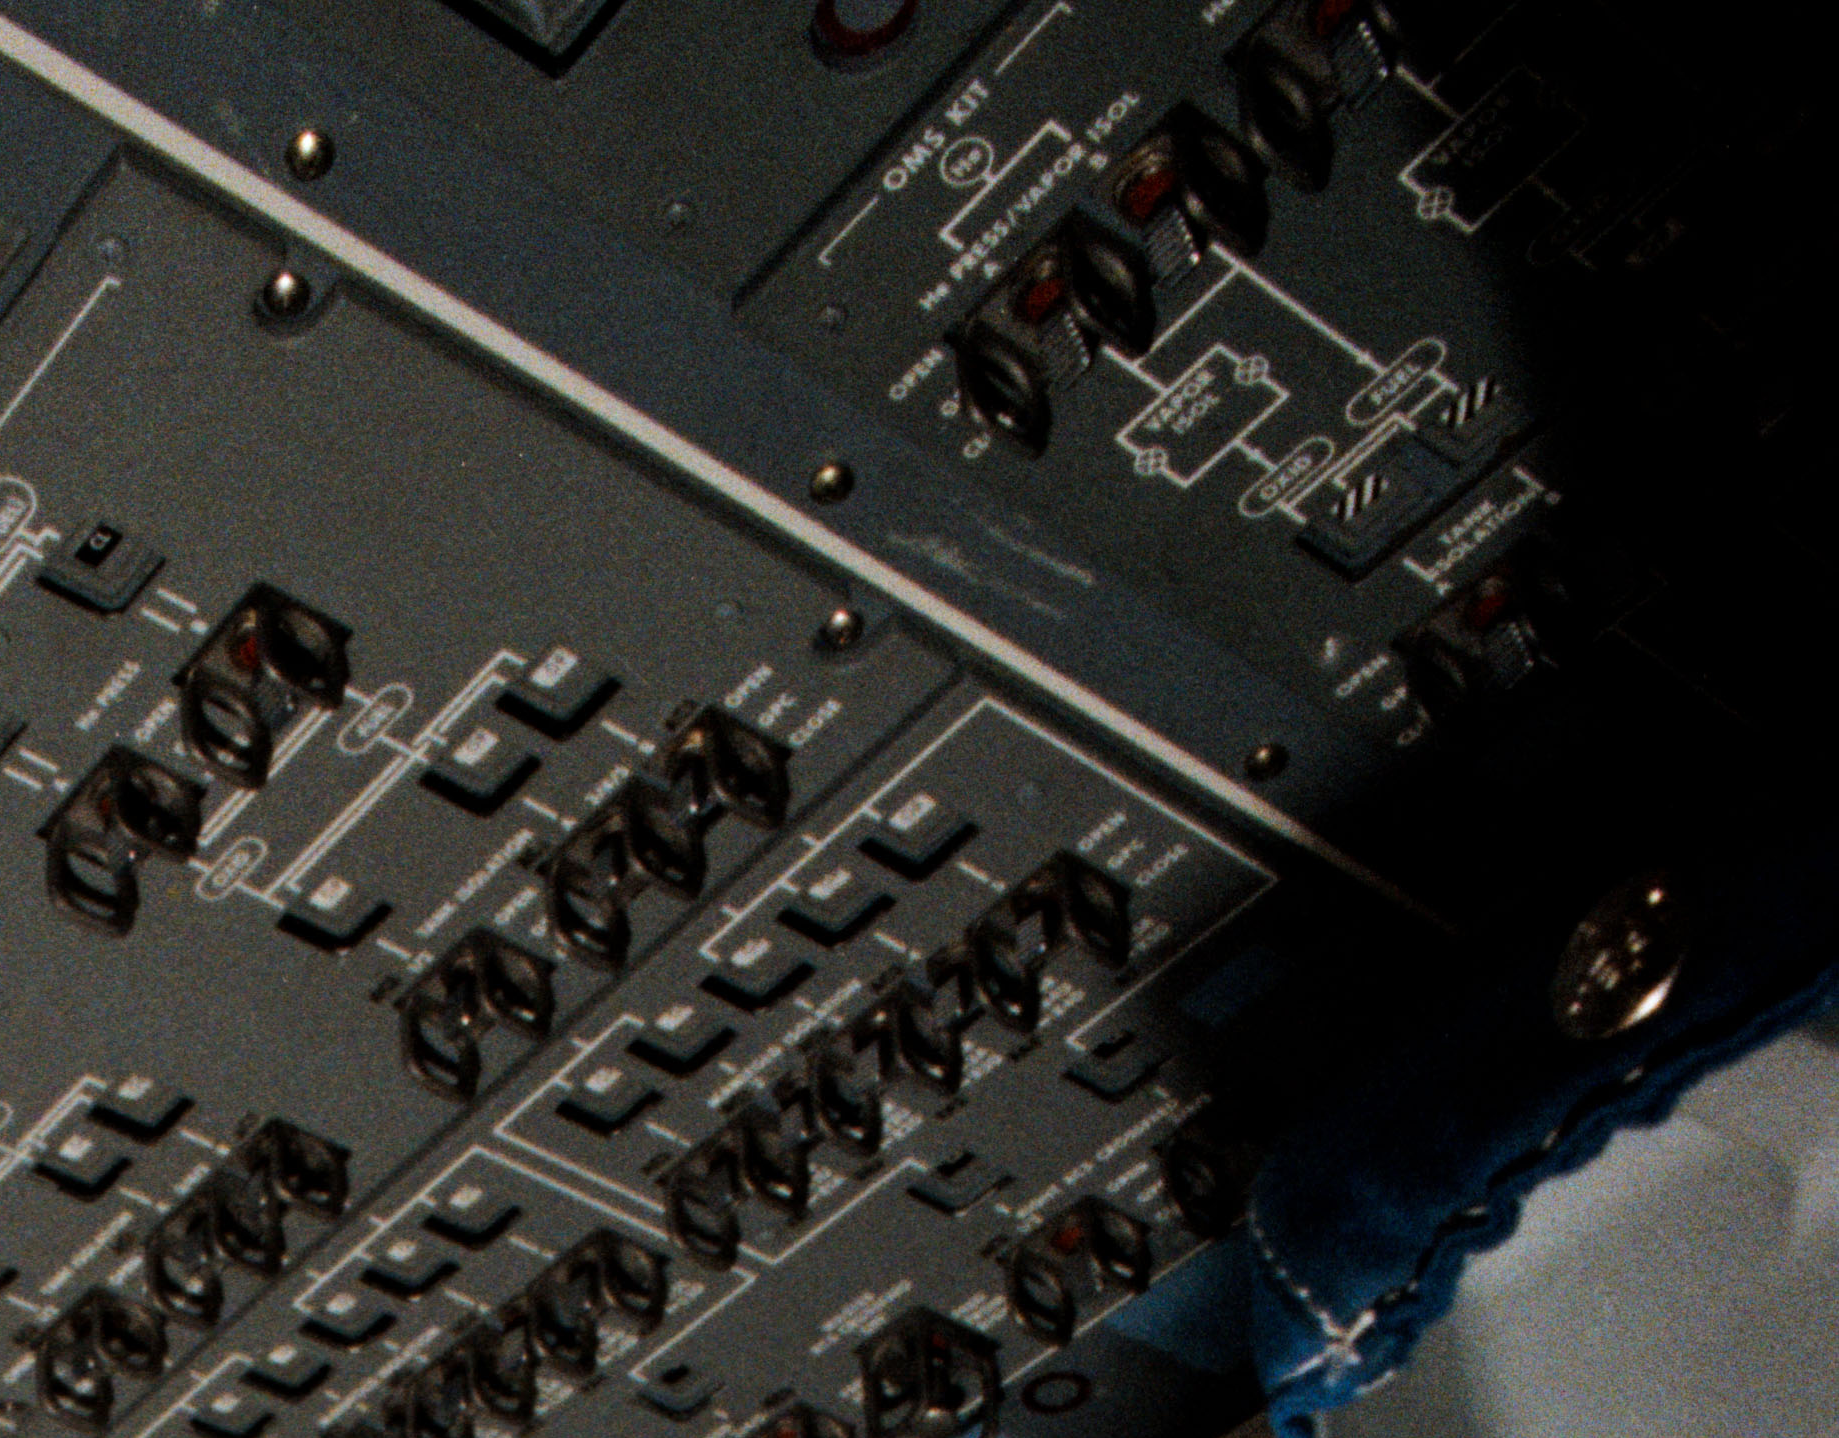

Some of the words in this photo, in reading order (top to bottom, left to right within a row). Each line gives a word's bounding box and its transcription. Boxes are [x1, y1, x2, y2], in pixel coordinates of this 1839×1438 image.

[882, 129, 946, 191] OMS
[945, 80, 988, 126] KIT
[950, 148, 982, 178] He
[920, 283, 949, 310] He
[949, 143, 1086, 281] PRESS/VAPOR
[1086, 93, 1139, 142] ISOL
[889, 349, 944, 400] OPEN
[1370, 364, 1420, 405] FUEL
[1146, 370, 1213, 430] VAPOR
[1171, 393, 1220, 434] ISOL
[1260, 455, 1312, 501] OXID
[1440, 500, 1494, 545] TANK
[724, 664, 773, 708] OPEN
[1336, 654, 1389, 697] OPEN
[758, 693, 795, 728] GPC
[789, 699, 842, 746] CLOSE
